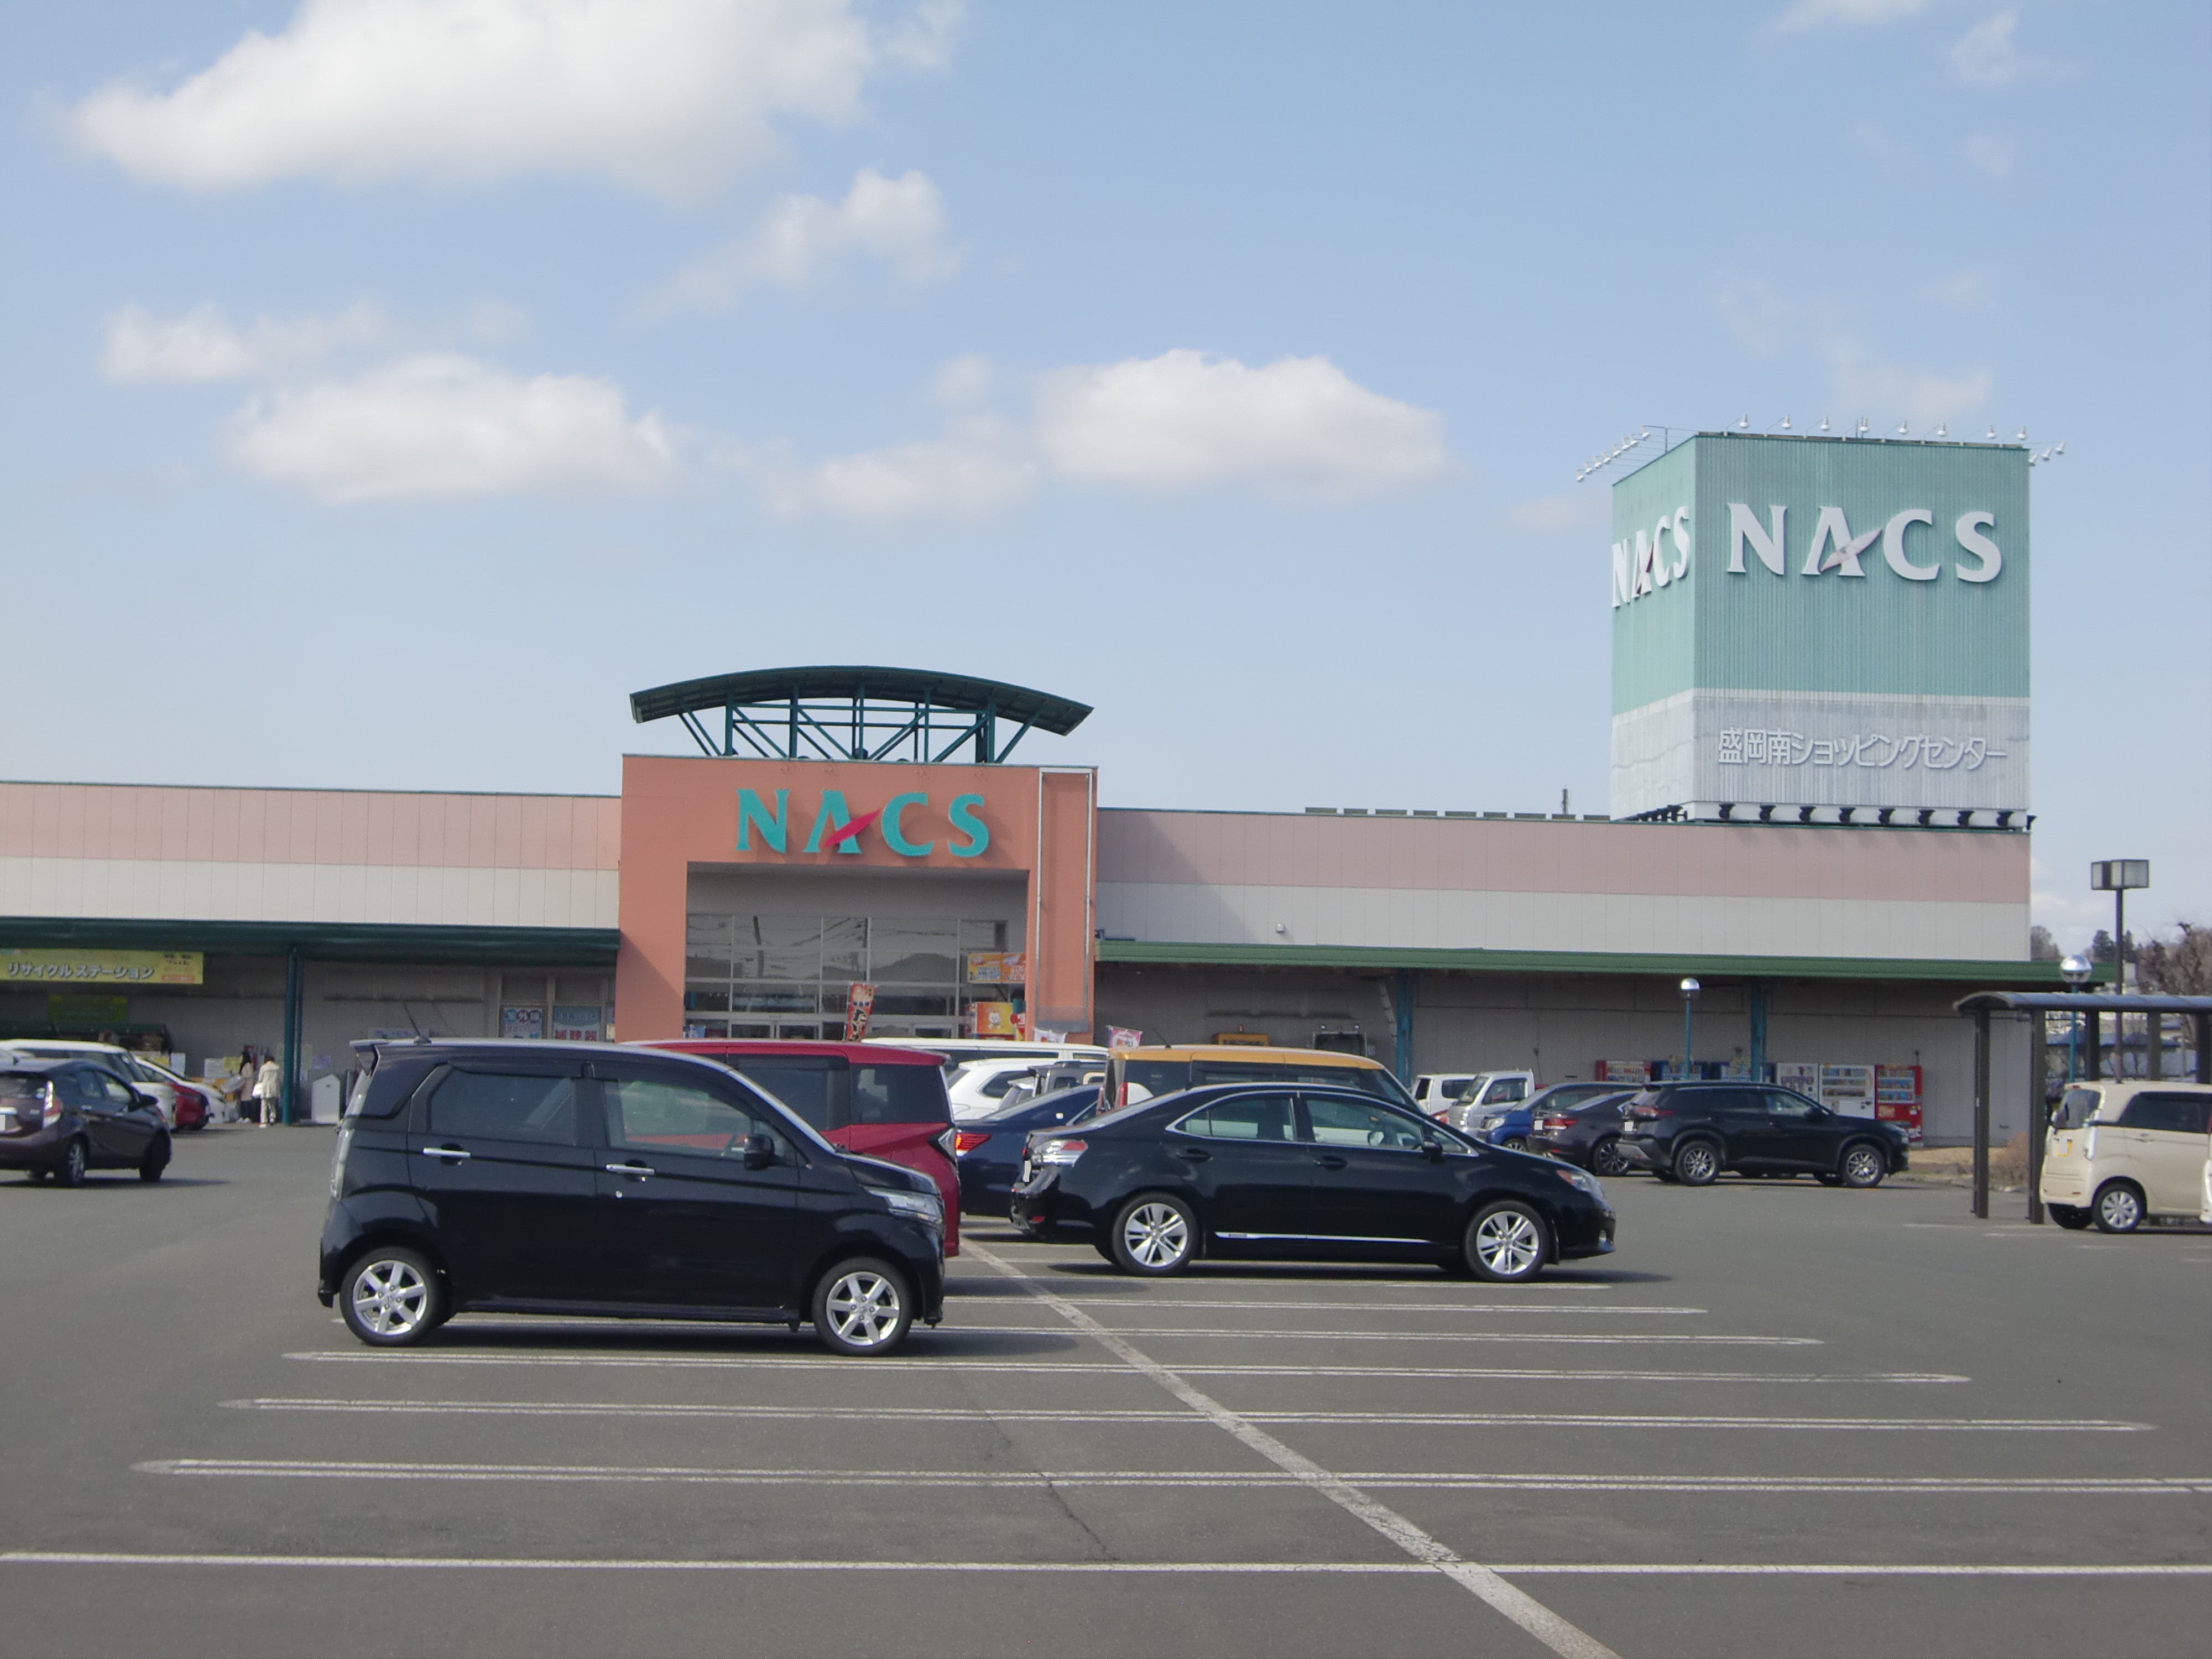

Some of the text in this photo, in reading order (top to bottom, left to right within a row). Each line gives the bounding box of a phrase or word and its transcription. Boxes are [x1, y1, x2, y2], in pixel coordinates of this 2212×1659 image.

[1611, 505, 1690, 609] NACS
[1726, 503, 2003, 583] NACS
[1718, 727, 2008, 771] 盛岡南ショッピングセンター
[734, 788, 990, 858] NACS
